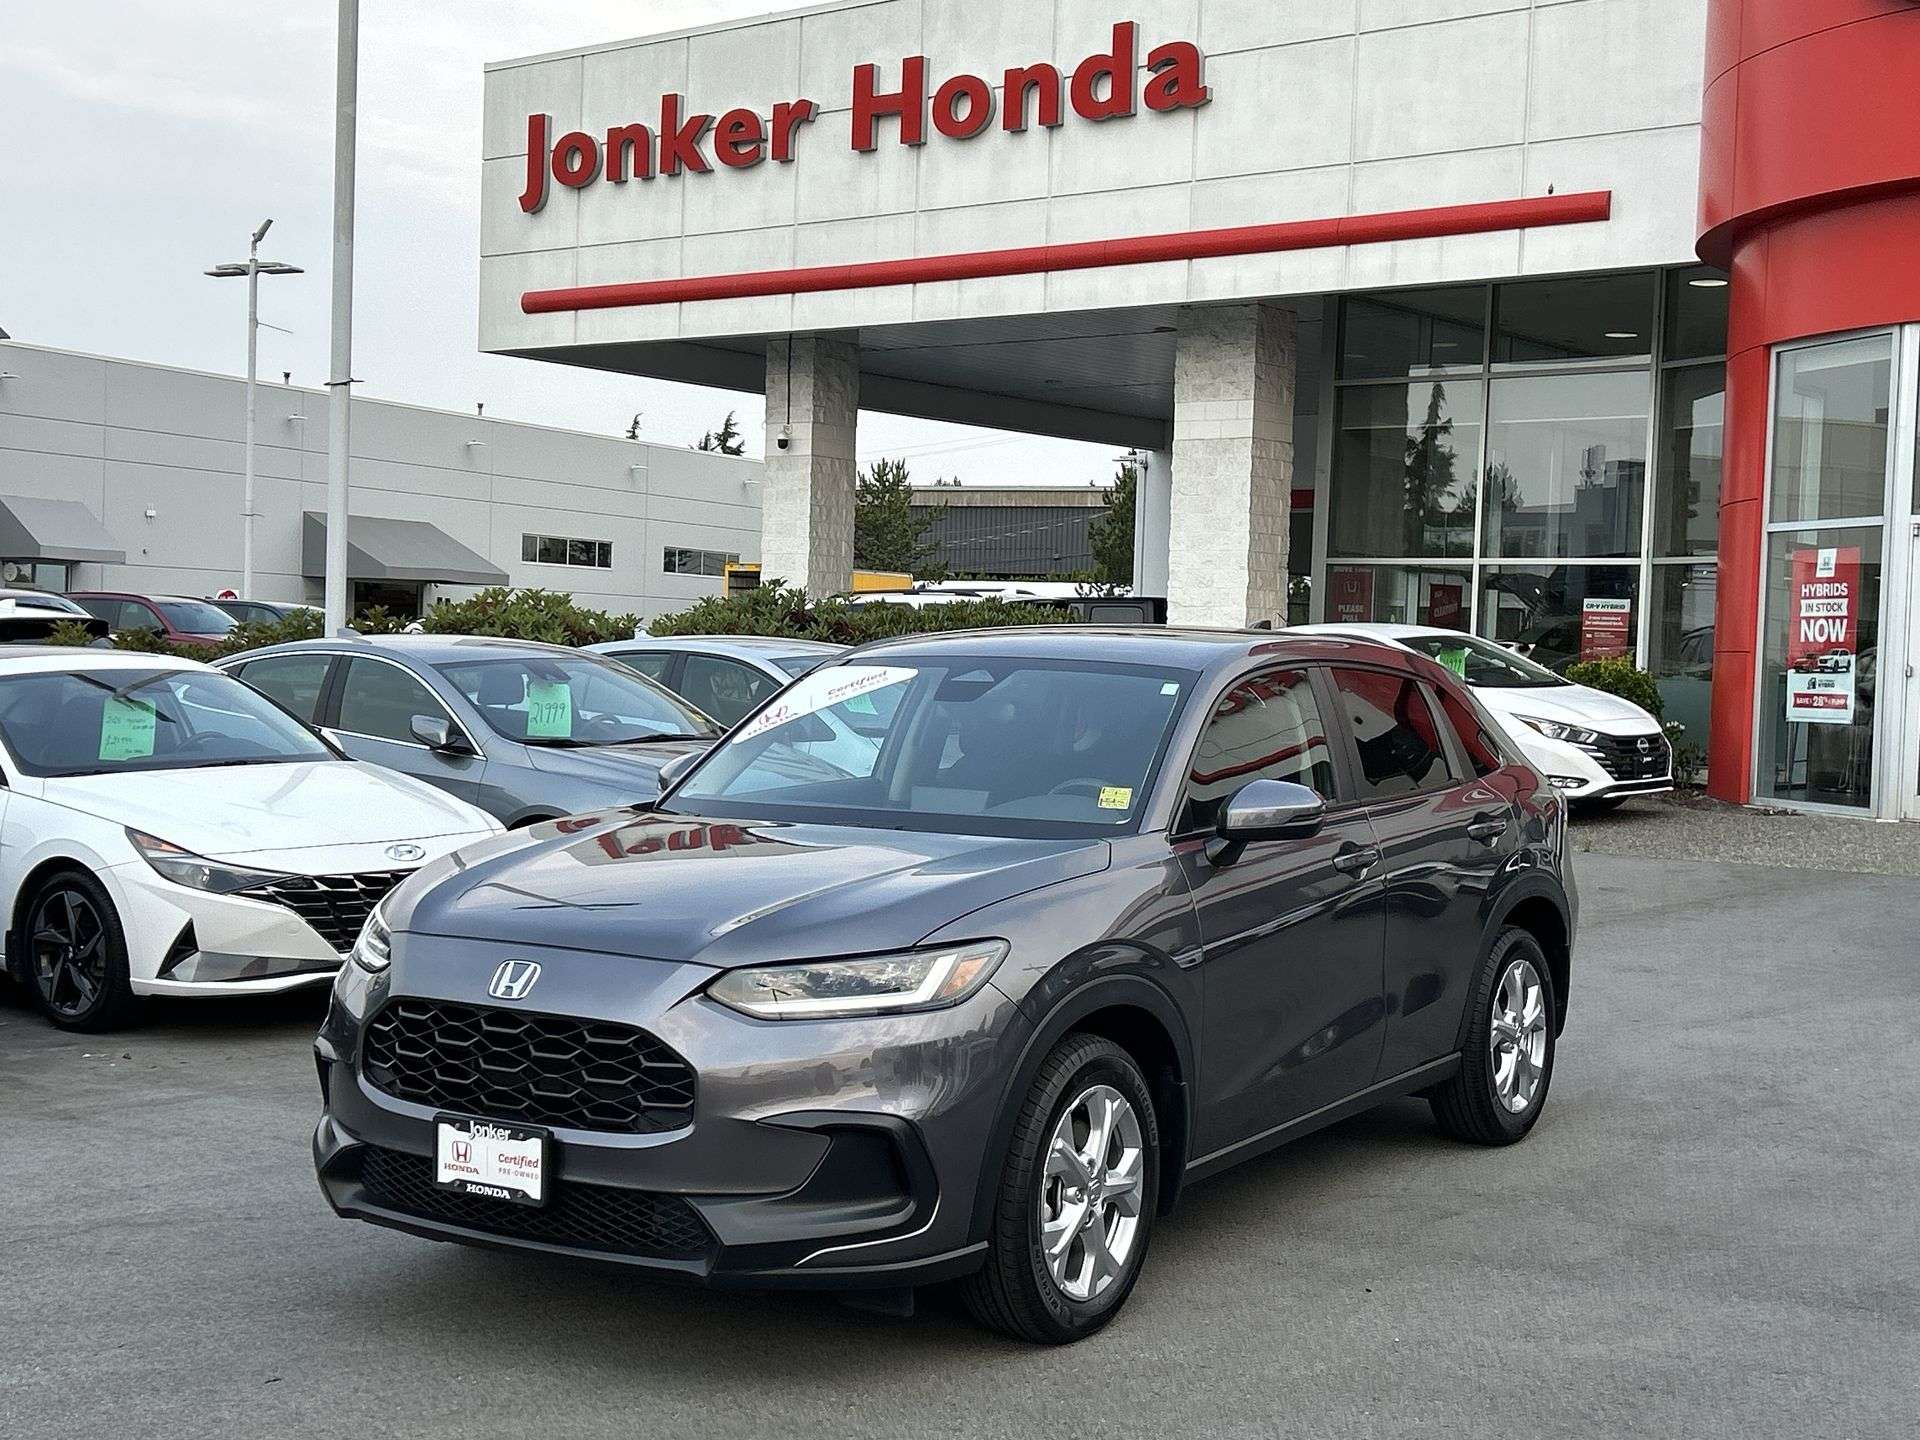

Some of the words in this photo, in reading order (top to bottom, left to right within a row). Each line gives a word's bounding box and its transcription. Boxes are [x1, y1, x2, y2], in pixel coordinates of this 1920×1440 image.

[519, 94, 818, 213] Jonker
[851, 20, 1212, 152] Honda
[1801, 582, 1848, 597] HYBRIDS
[1338, 604, 1364, 613] PLEASE
[1805, 602, 1814, 613] IN
[1816, 601, 1843, 613] STOCK
[1800, 618, 1848, 643] NOW
[828, 669, 887, 696] Certified
[469, 1120, 511, 1141] Jonker
[443, 1162, 480, 1175] HONDA
[498, 1153, 539, 1169] Certified
[465, 1183, 511, 1200] HONDA
